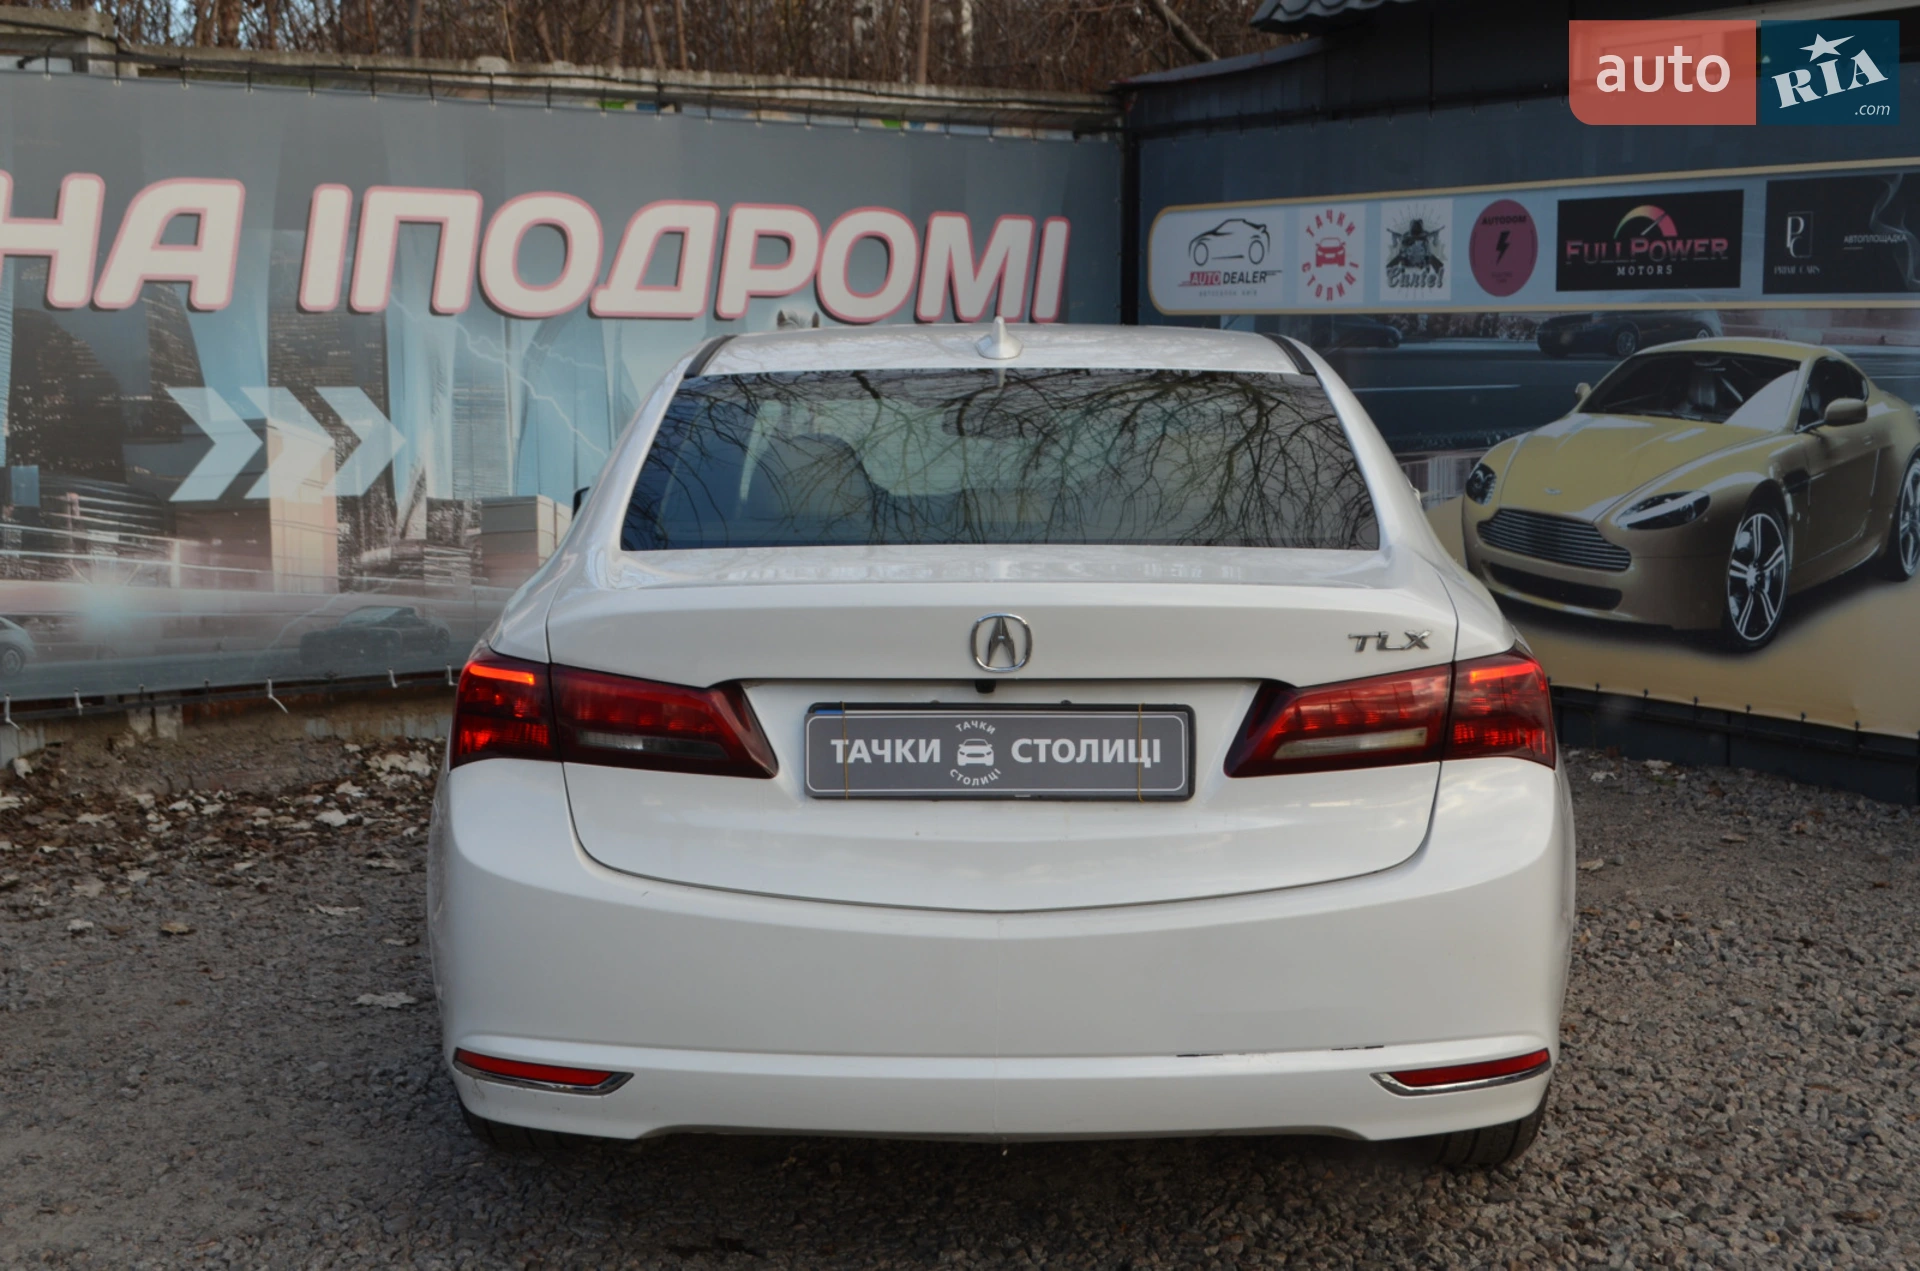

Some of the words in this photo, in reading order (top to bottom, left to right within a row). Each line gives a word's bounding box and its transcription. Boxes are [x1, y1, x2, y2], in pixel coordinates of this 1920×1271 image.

[1305, 208, 1356, 237] ТАЧКИ
[0, 169, 246, 310] НА
[299, 183, 1071, 323] ІПОДРОМІ
[1301, 261, 1359, 302] СТОЛИЦІ
[1616, 264, 1673, 276] MOTORS
[1347, 630, 1432, 653] TLX
[955, 720, 996, 735] ТАЧКИ
[830, 738, 941, 764] ТАЧКИ
[1010, 737, 1161, 768] СТОЛИЦІ
[950, 768, 1001, 786] СТОЛИЦІ
